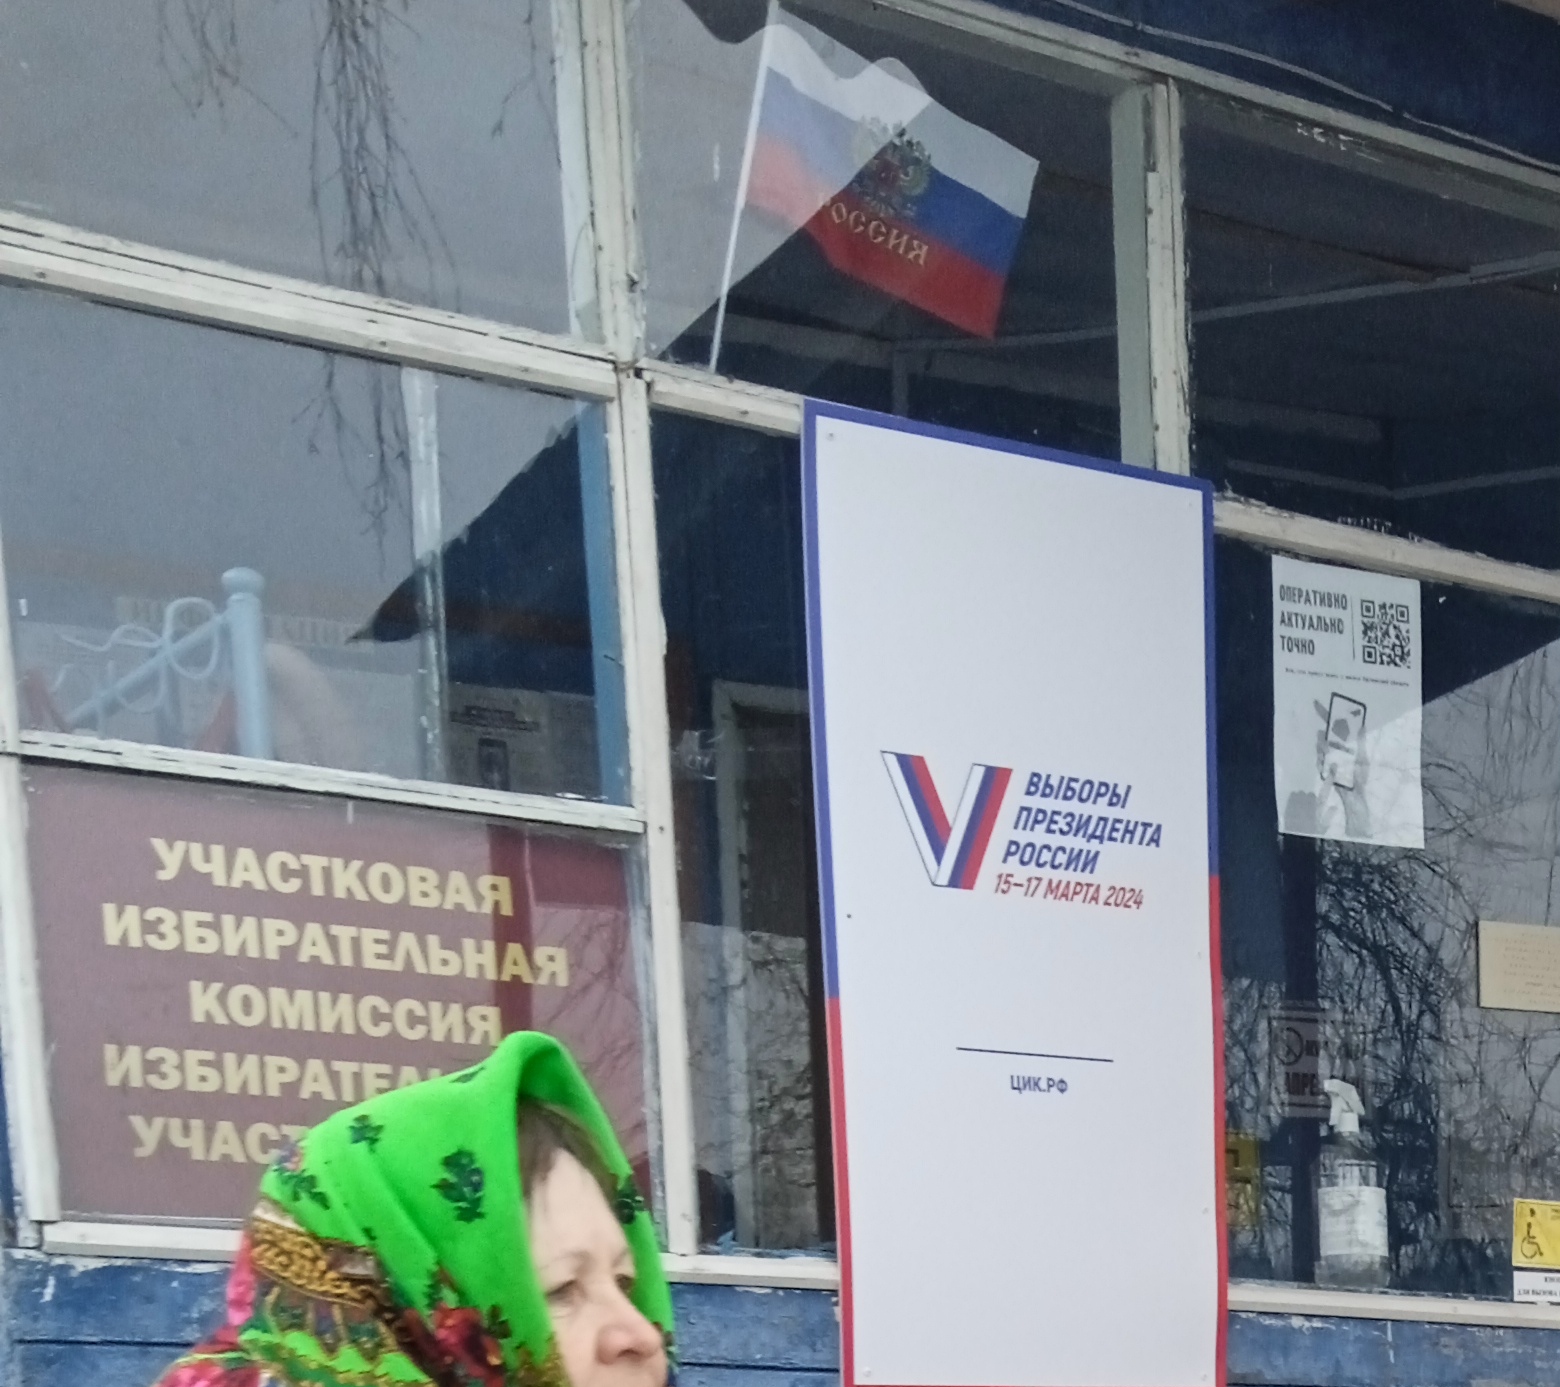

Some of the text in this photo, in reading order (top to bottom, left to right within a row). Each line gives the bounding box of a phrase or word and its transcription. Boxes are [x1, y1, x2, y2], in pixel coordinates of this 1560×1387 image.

[1279, 584, 1348, 610] ОПЕРАТИВНО
[1279, 610, 1345, 634] АКТУАЛЬНО
[1279, 635, 1315, 655] ТОЧНО
[1024, 772, 1132, 809] ВЫБОРЫ
[1013, 806, 1163, 848] ПРЕЗИДЕНТА
[1001, 839, 1101, 874] РОССИИ
[150, 837, 514, 916] УЧАСТКОВАЯ
[1043, 878, 1102, 905] МАРТА
[1103, 885, 1145, 910] 2024
[103, 902, 570, 987] ИЗБИРАТЕЛЬНАЯ
[188, 980, 502, 1047] КОМИССИЯ
[103, 1044, 442, 1103] ИЗБИРАТЕ
[1010, 1075, 1068, 1094] ЦИК.РФ
